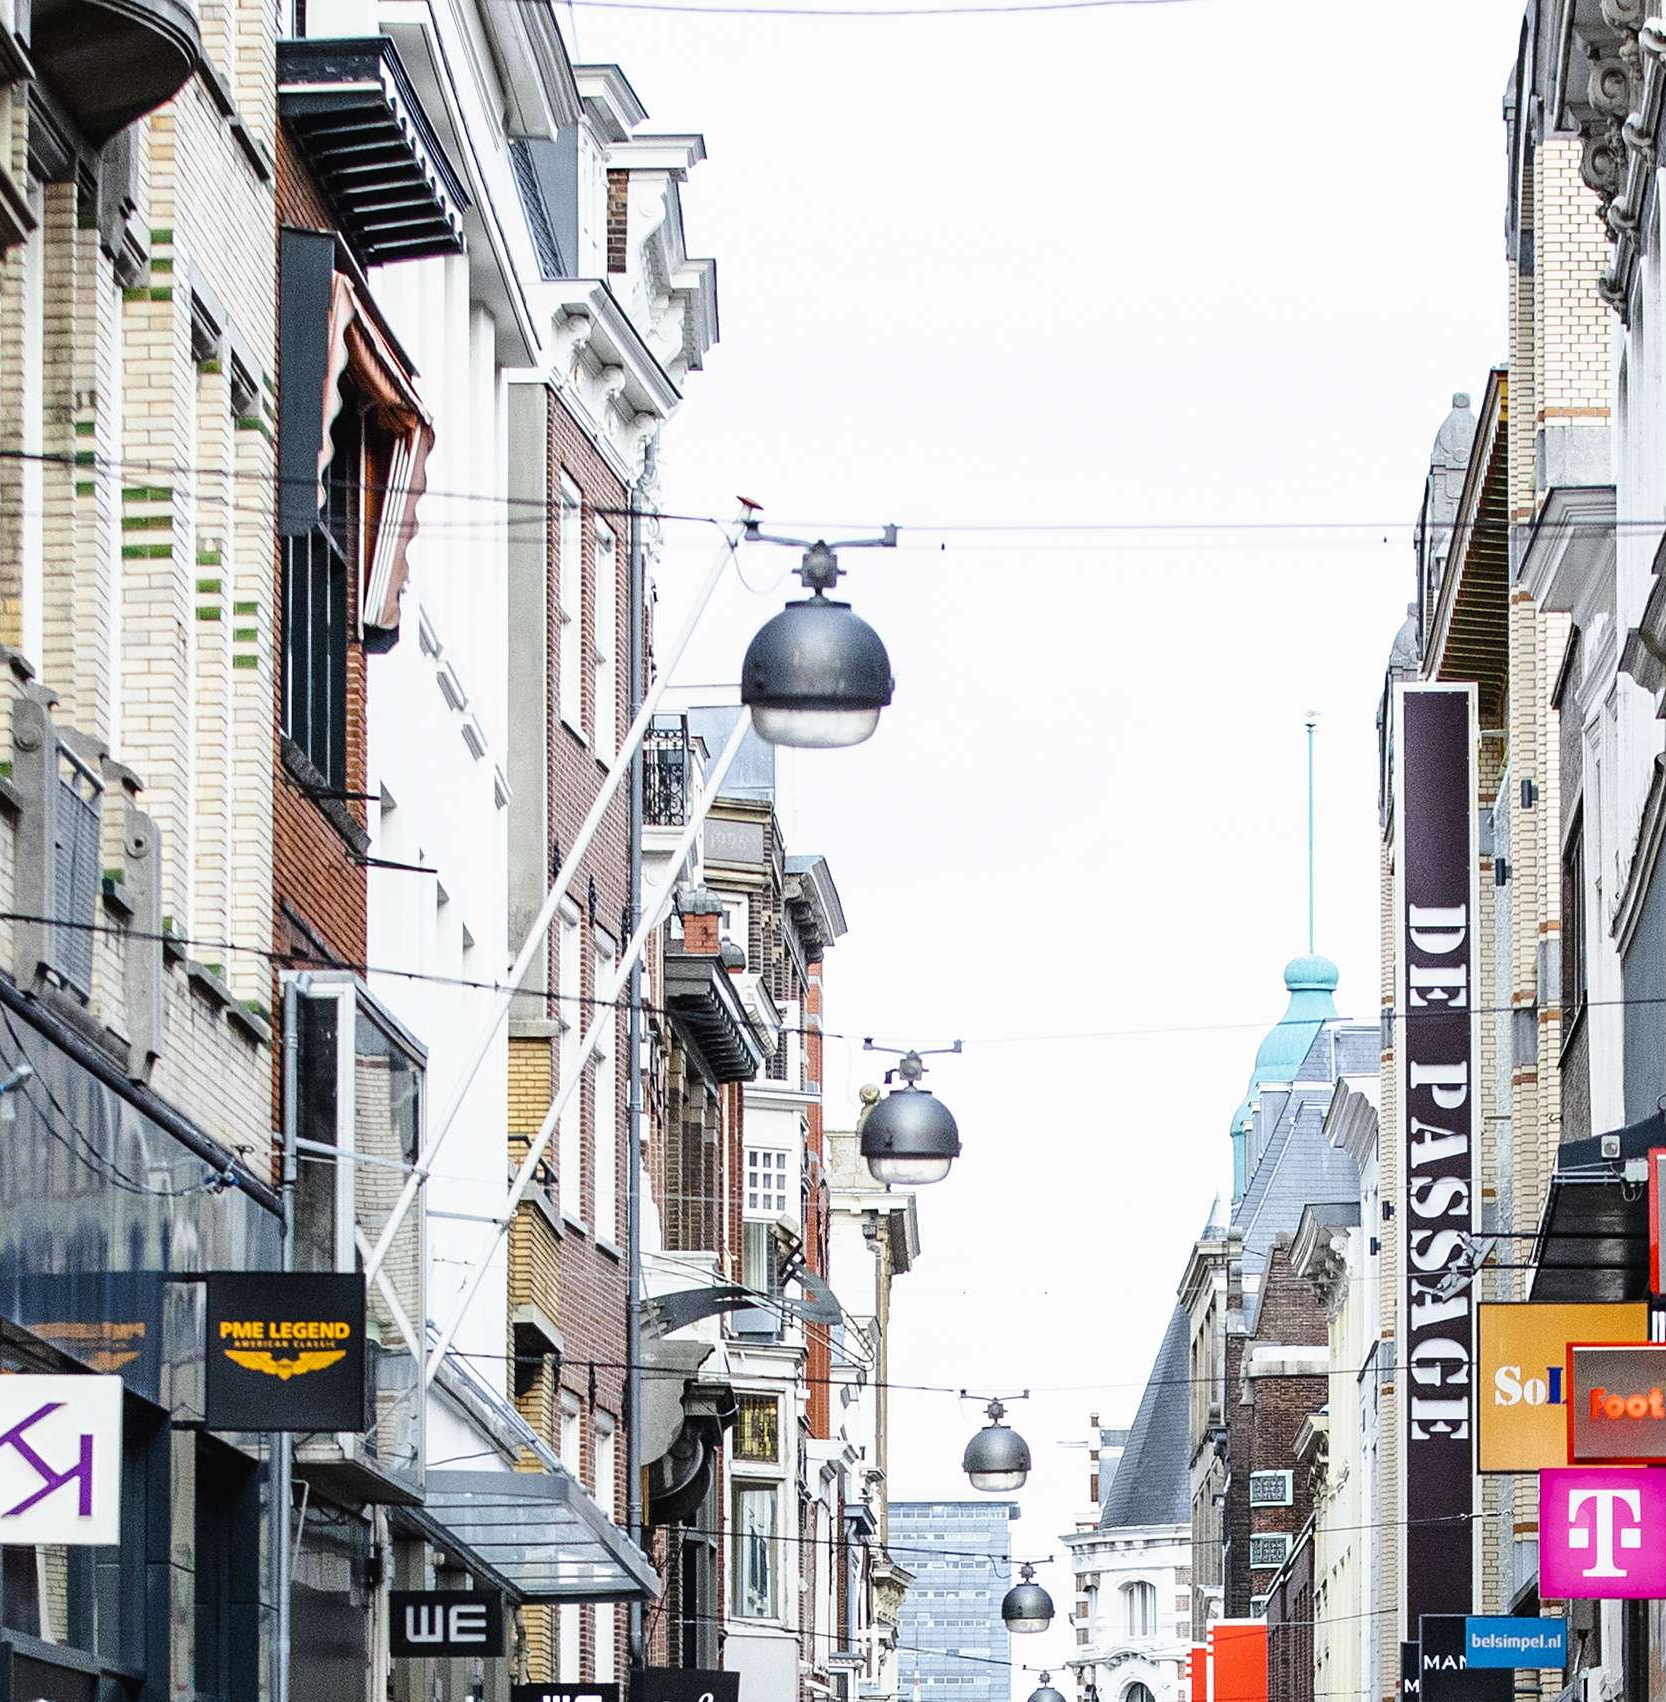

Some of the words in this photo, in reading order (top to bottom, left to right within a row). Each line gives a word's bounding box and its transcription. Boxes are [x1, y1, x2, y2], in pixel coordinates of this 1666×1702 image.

[1408, 904, 1467, 1009] DE
[1409, 1061, 1470, 1442] PASSAGE
[219, 1320, 265, 1340] PME
[269, 1320, 351, 1340] LEGEND
[1493, 1365, 1566, 1406] SoL
[1589, 1386, 1664, 1420] Foot
[1568, 1488, 1642, 1578] T
[405, 1604, 487, 1643] WE
[1471, 1633, 1562, 1653] belsimpel.nl
